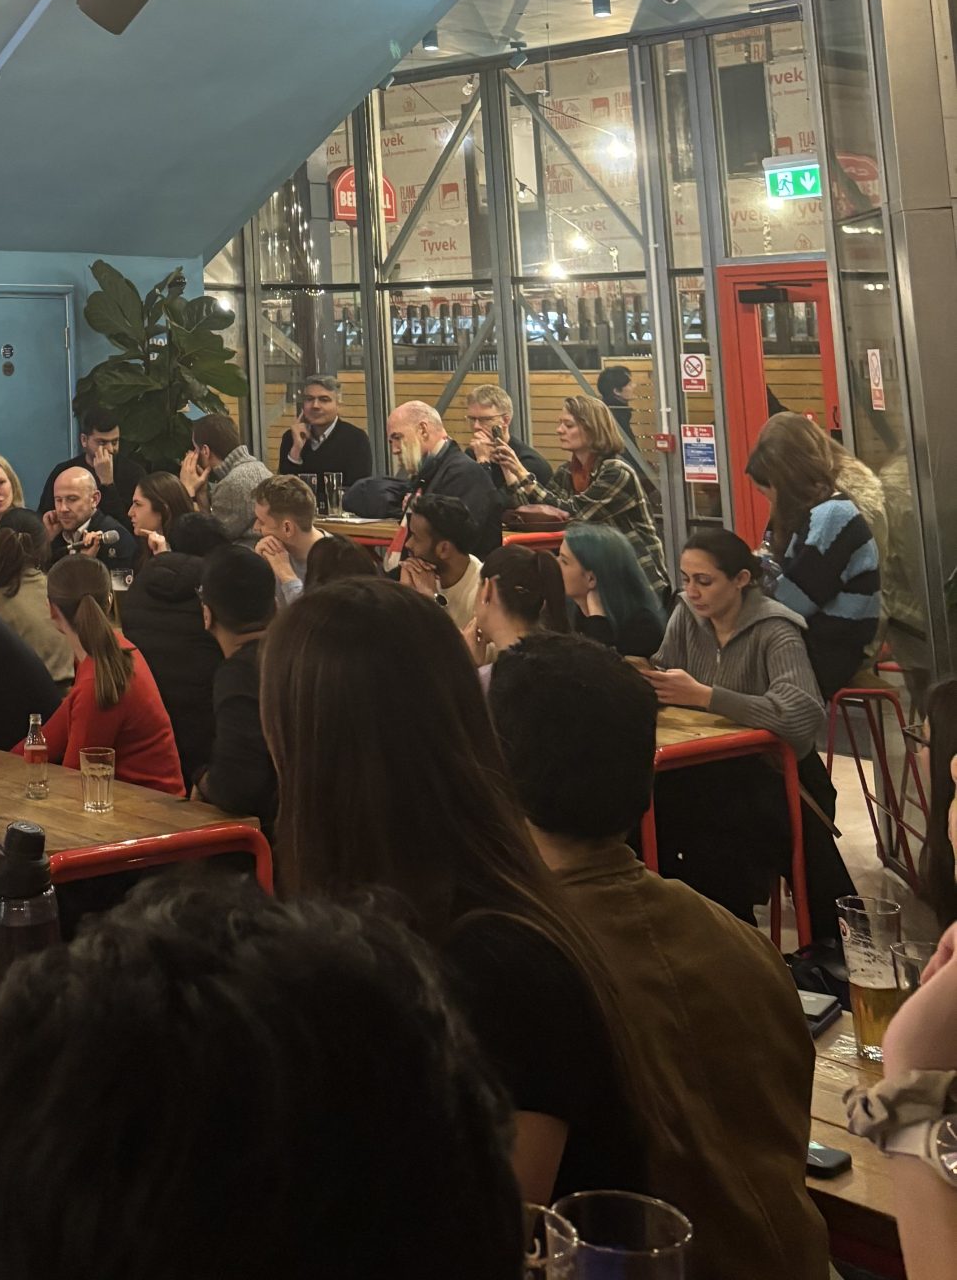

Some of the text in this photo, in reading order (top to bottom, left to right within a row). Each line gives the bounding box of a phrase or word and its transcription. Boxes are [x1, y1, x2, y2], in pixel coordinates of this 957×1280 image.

[769, 68, 803, 86] vek
[381, 133, 404, 147] vek
[421, 238, 456, 254] Tyvek
